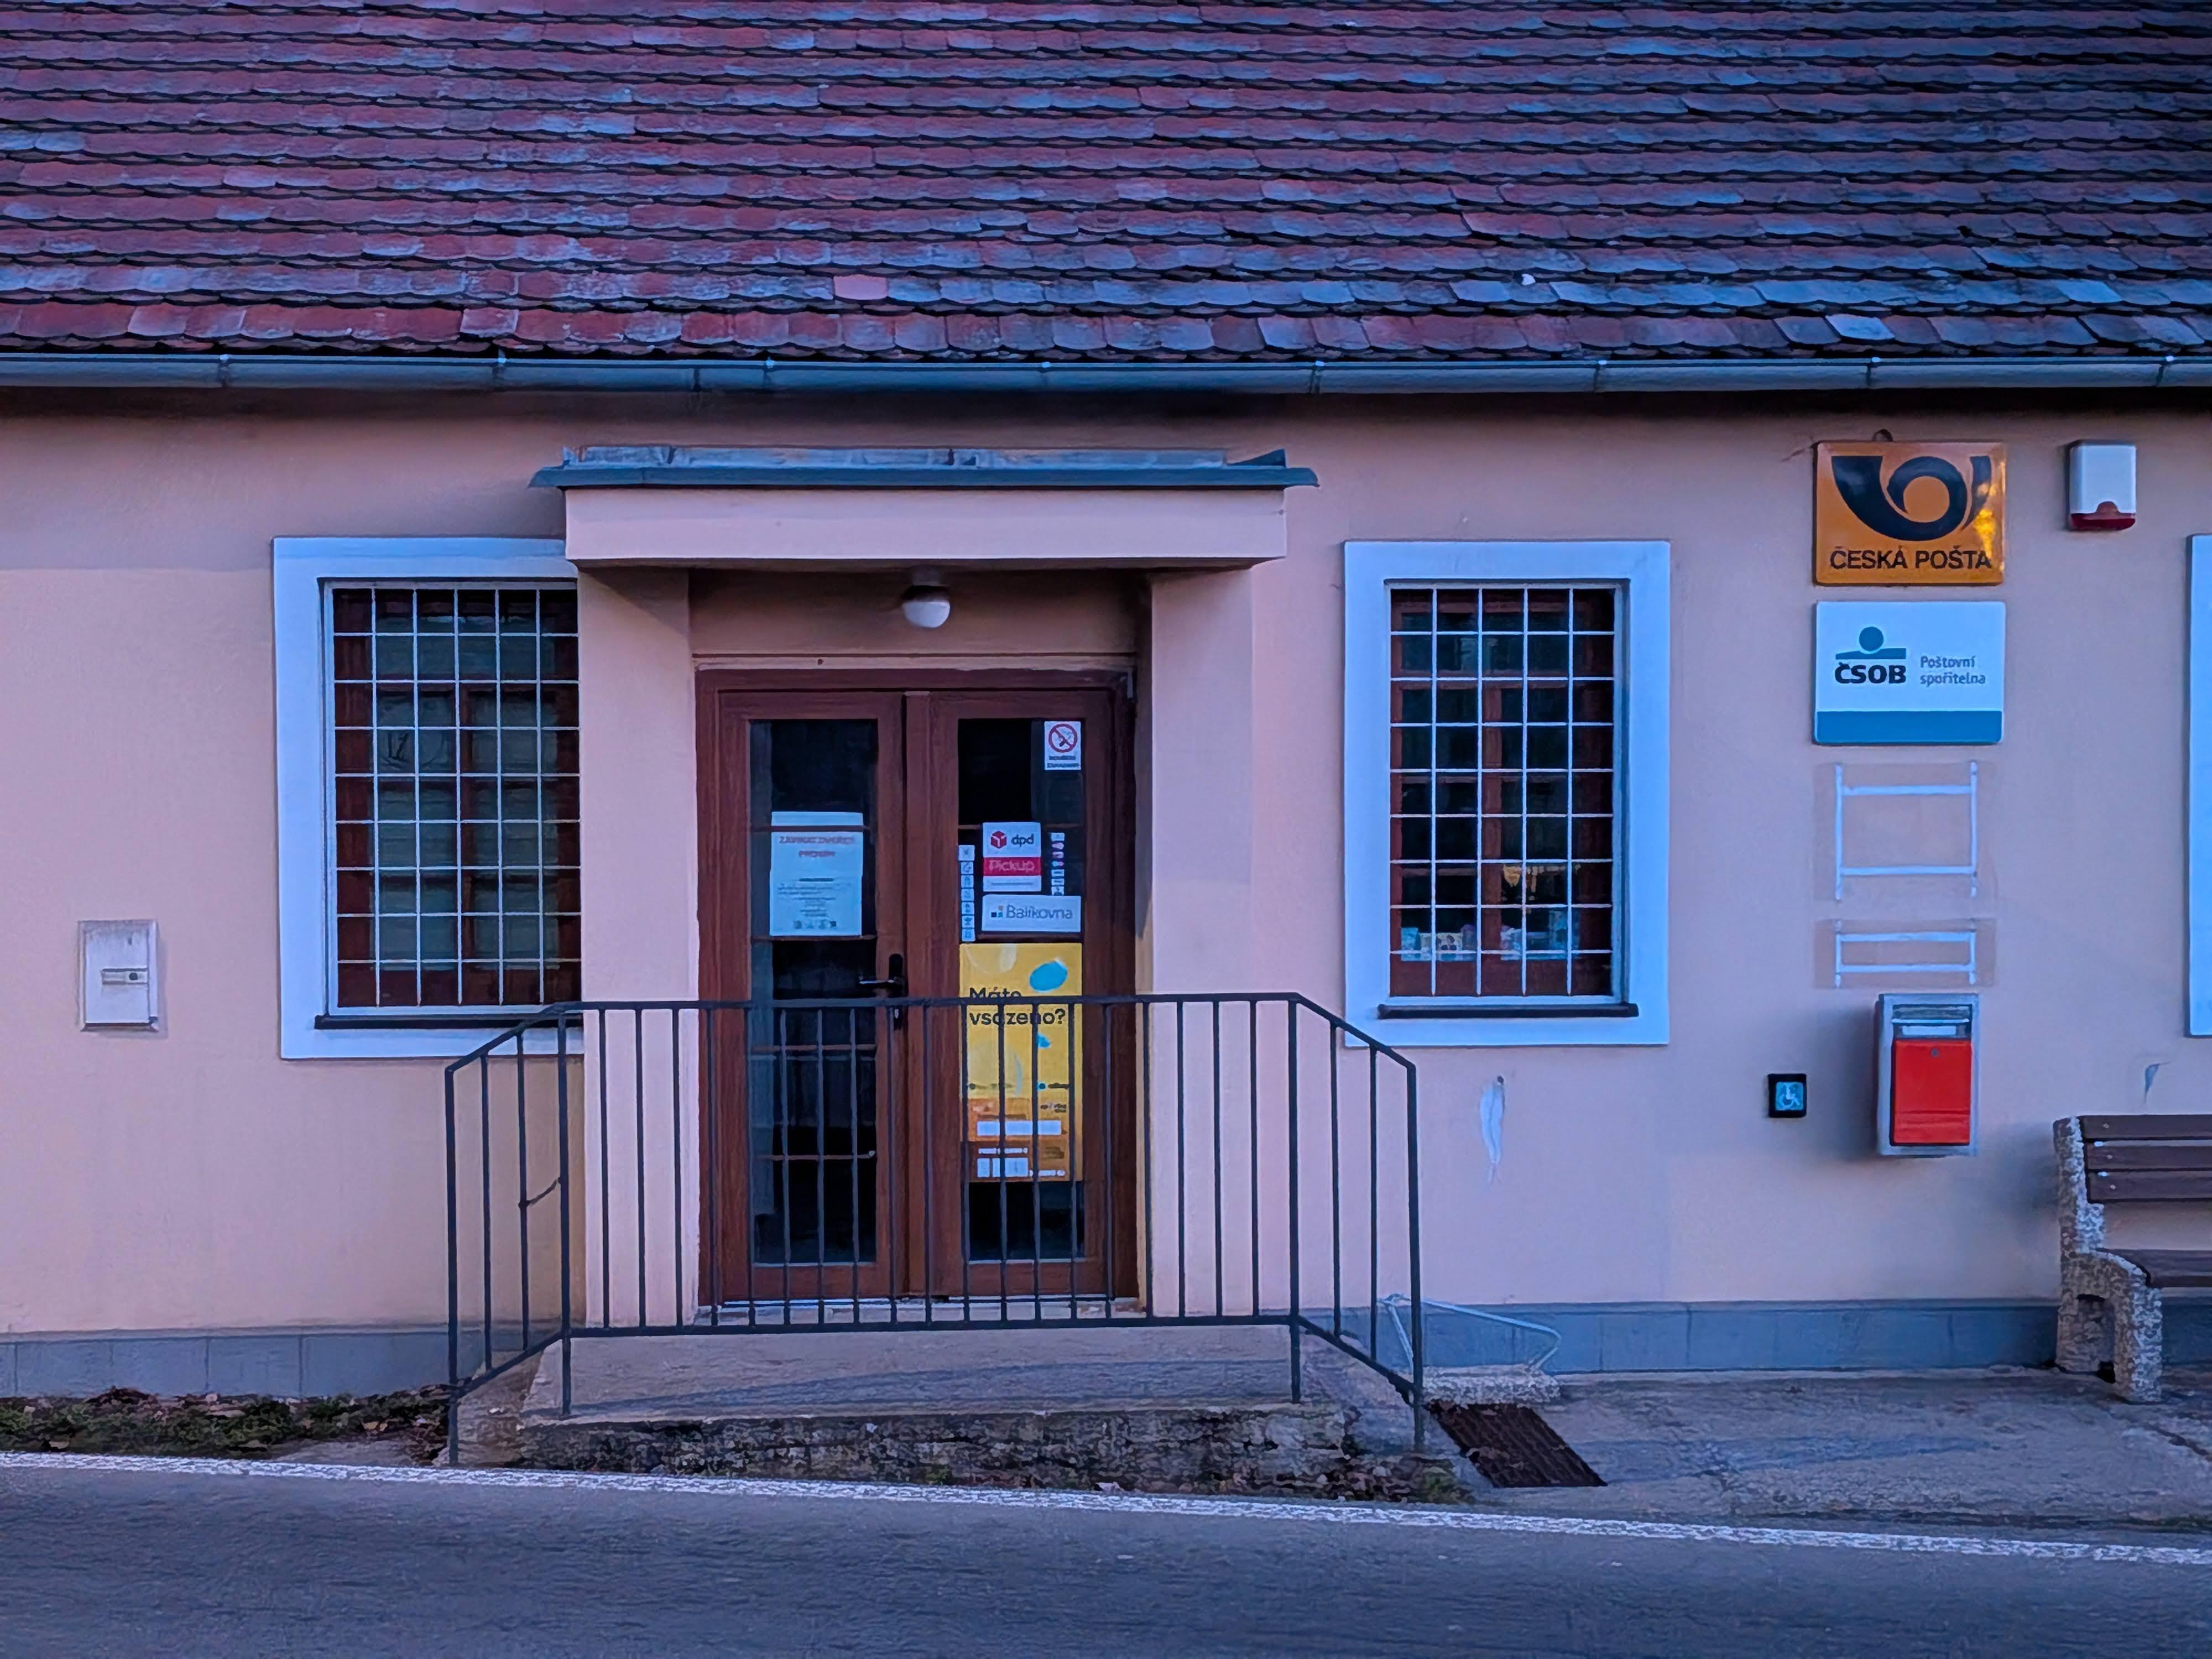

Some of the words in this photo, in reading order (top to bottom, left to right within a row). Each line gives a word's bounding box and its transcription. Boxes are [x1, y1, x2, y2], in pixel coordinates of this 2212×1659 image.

[1830, 545, 1908, 570] ČESKÁ
[1915, 545, 1992, 570] POŠTA
[1920, 655, 1976, 669] Poštovní
[1834, 662, 1907, 685] ČSOB
[1919, 672, 1986, 687] spořitelna
[1010, 833, 1035, 848] dpd
[988, 859, 1035, 873] Pickup
[1006, 904, 1073, 919] Balíkovna
